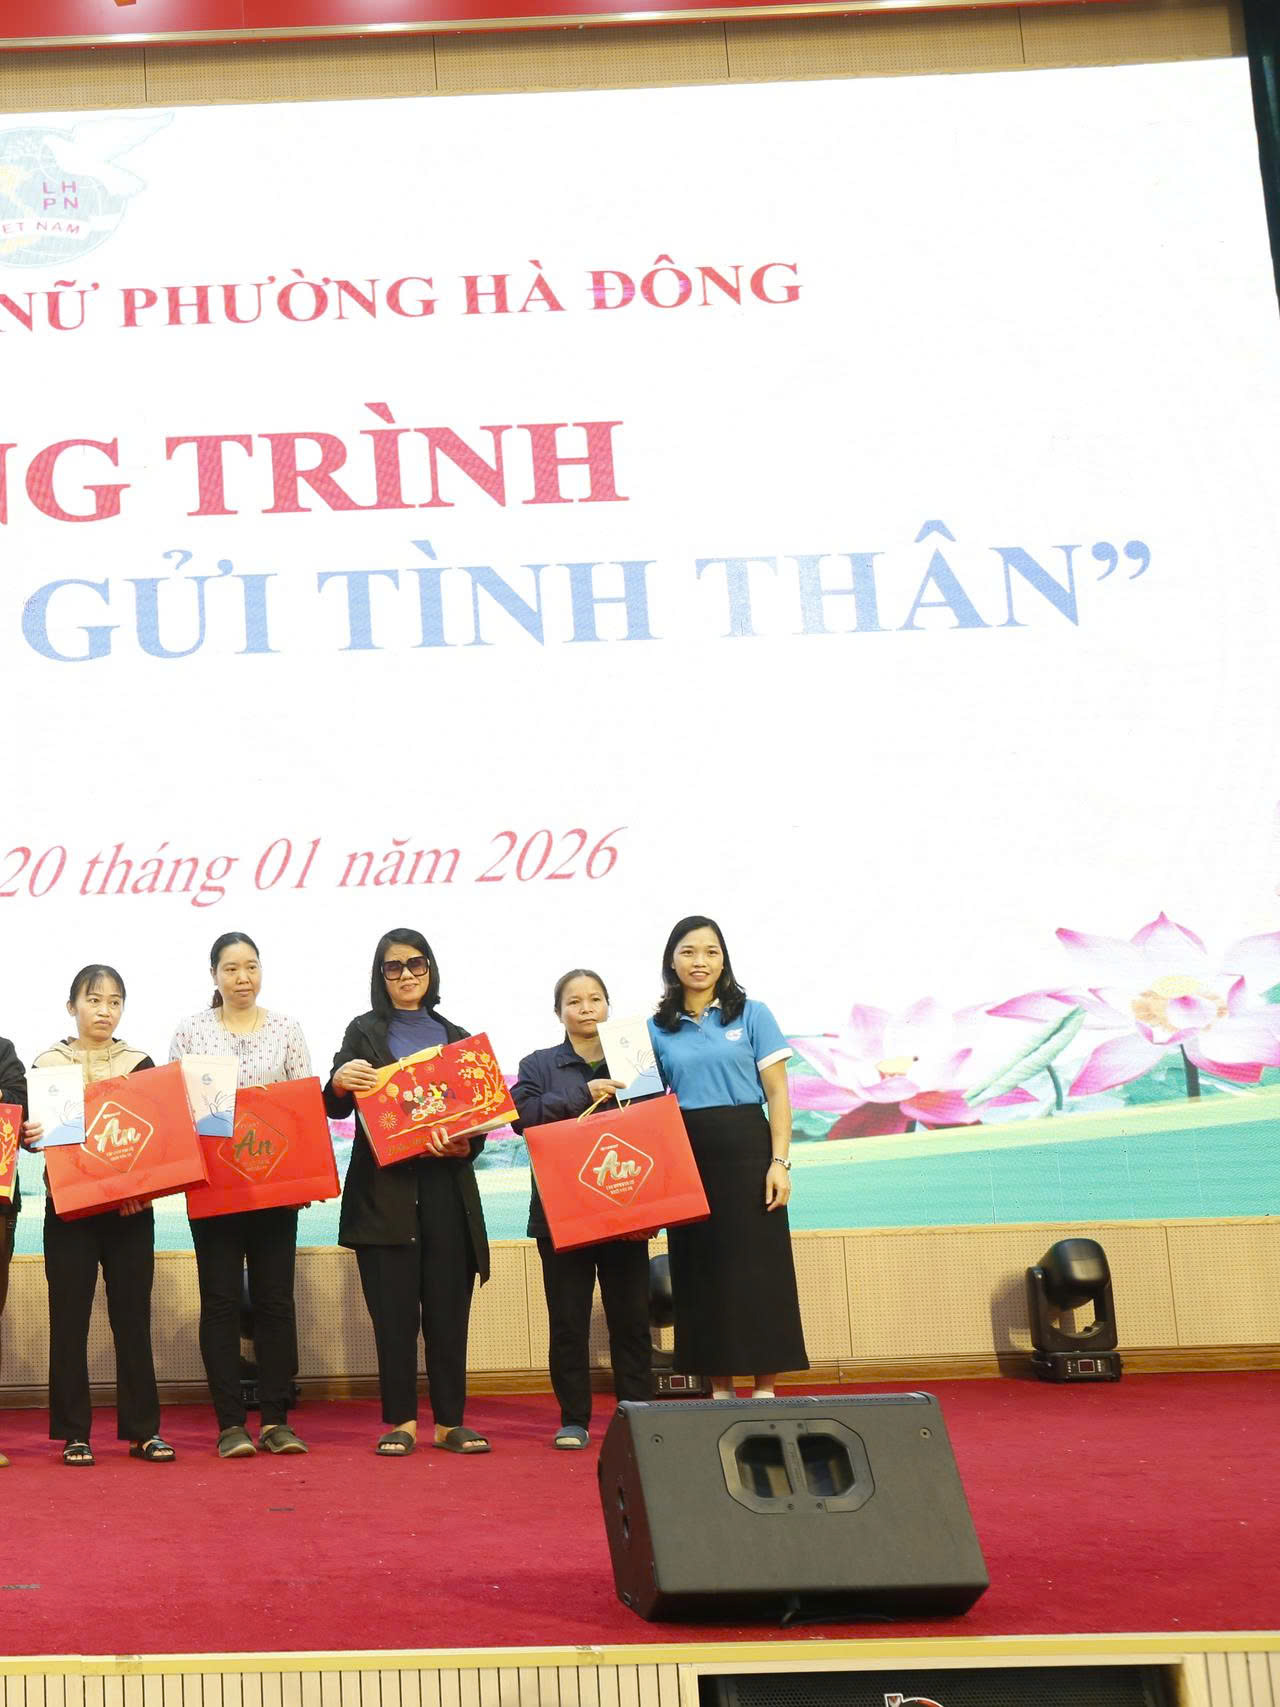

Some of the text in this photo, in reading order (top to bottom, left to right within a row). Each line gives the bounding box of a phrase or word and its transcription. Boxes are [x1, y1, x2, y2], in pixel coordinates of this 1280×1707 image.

[36, 221, 81, 235] NAM
[119, 268, 439, 328] PHƯỜNG
[462, 259, 567, 316] HÀ
[588, 254, 804, 311] ĐÔNG
[165, 402, 630, 517] TRÌNH
[21, 550, 279, 663] GỬI
[317, 540, 663, 650] TÌNH
[695, 519, 1152, 637] THÂN”
[79, 840, 240, 907] tháng
[253, 837, 322, 891] 01
[337, 834, 461, 888] năm
[475, 826, 629, 883] 2026
[233, 1129, 273, 1160] An
